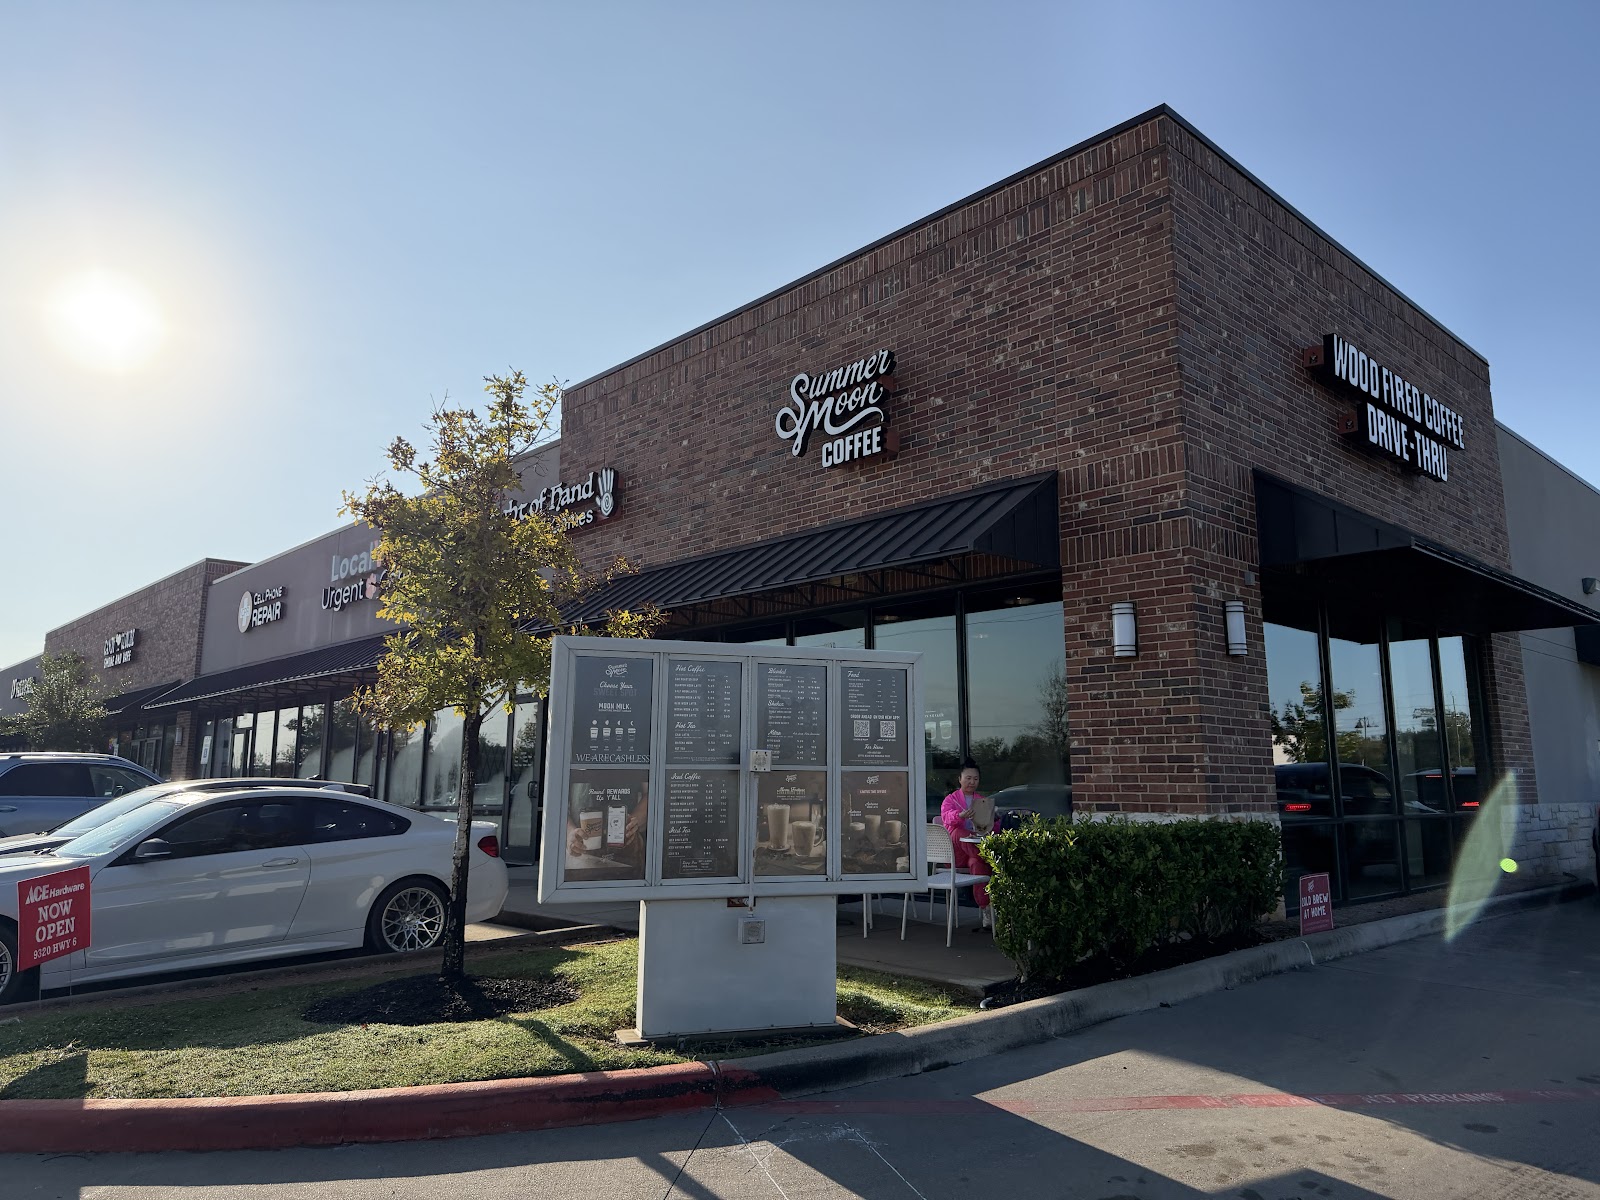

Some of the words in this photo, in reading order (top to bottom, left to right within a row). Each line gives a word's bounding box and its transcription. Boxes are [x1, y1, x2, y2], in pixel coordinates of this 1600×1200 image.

[775, 349, 892, 439] Summer
[1333, 333, 1380, 399] WOOD
[1381, 366, 1422, 424] FIRED
[1422, 392, 1466, 450] COFFEE
[792, 381, 885, 457] Moon
[821, 425, 882, 468] COFFEE
[1366, 402, 1448, 482] DRIVE-THRU
[331, 541, 374, 582] Local
[265, 586, 283, 601] PHONE
[321, 578, 364, 612] Urgent
[251, 601, 282, 628] REPAIR
[598, 702, 615, 710] MOON
[575, 753, 591, 762] WE
[609, 753, 650, 763] CASHLESS
[25, 884, 50, 905] ACE
[49, 882, 85, 899] Hardware
[1312, 893, 1329, 905] BREW
[38, 899, 73, 923] NOW
[1303, 908, 1310, 920] AT
[1311, 906, 1327, 918] HOME
[35, 917, 76, 943] OPEN
[33, 945, 51, 960] 9320
[52, 938, 72, 954] HWY
[72, 937, 78, 946] 6
[1402, 1091, 1505, 1103] PARKING
